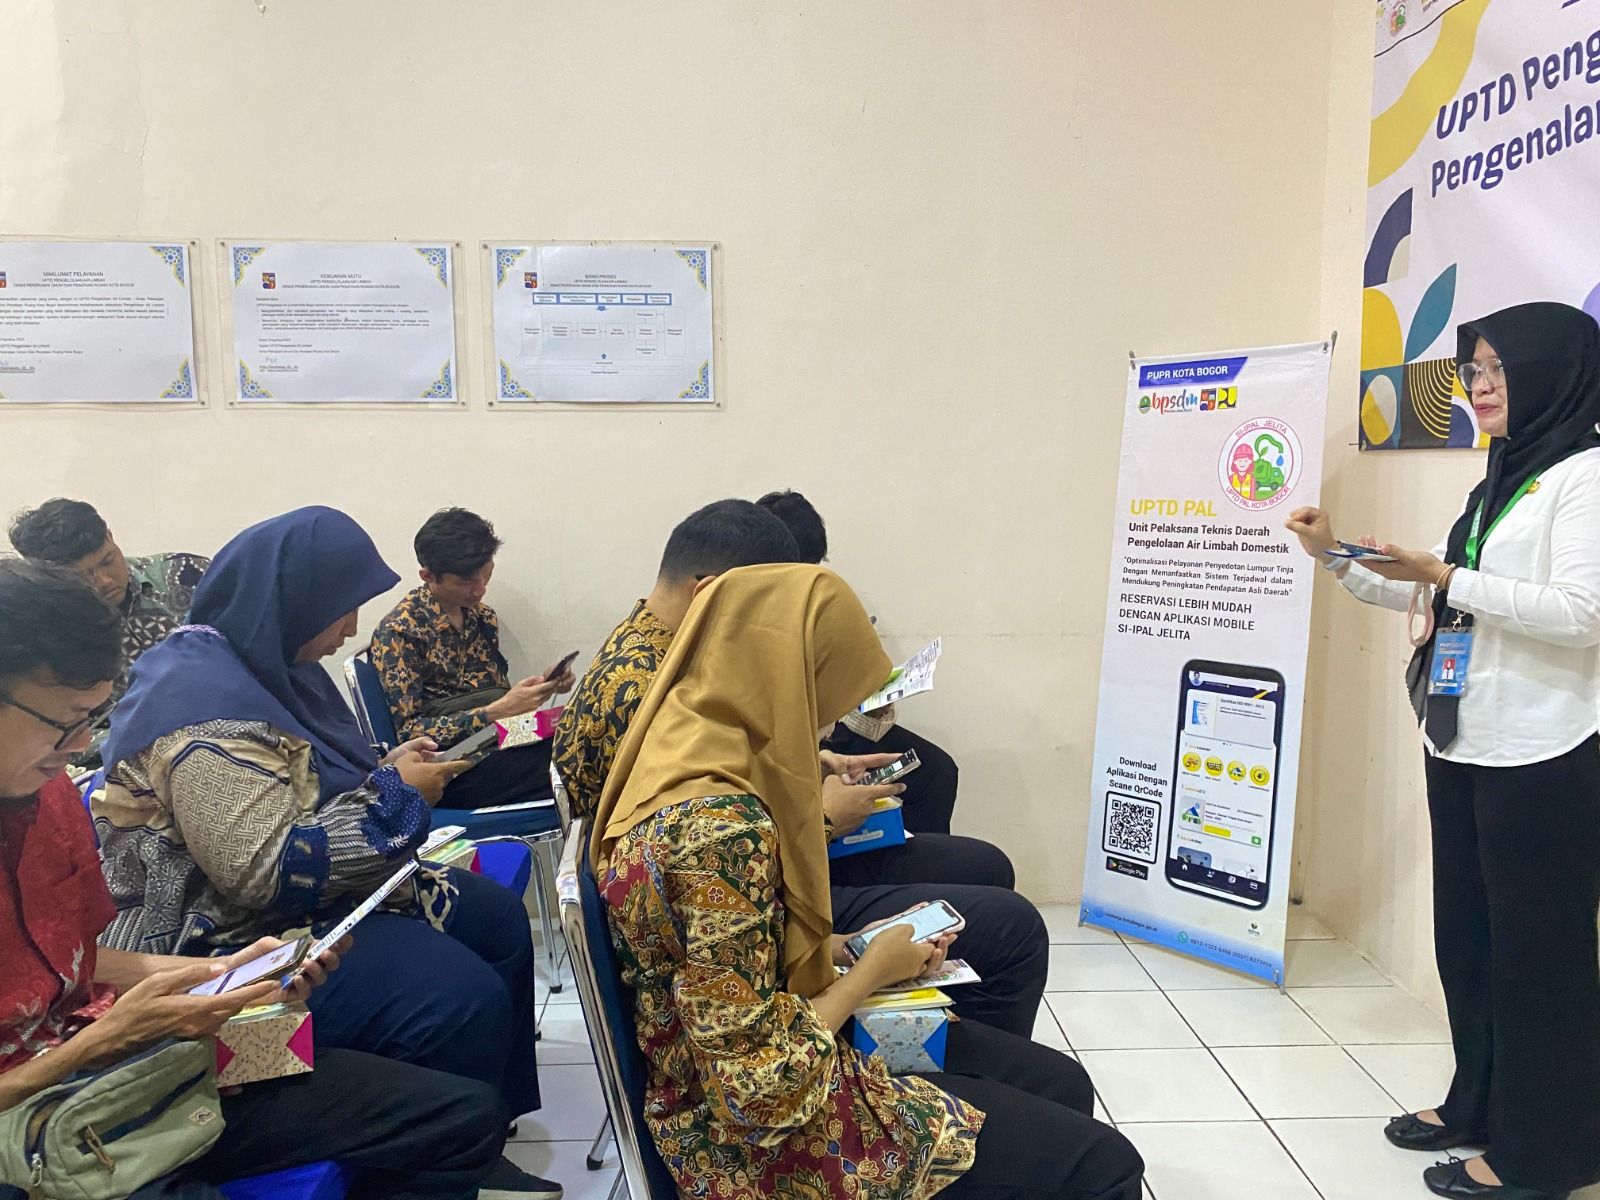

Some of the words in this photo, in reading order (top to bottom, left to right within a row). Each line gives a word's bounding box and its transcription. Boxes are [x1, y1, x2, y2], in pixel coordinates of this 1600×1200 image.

[1436, 73, 1516, 140] UPTD
[1147, 369, 1171, 380] PUPR
[1172, 367, 1195, 378] KOTA
[1196, 365, 1228, 377] BOGOR
[1152, 388, 1198, 415] bpsdm
[1264, 420, 1287, 434] JELITA
[1226, 486, 1240, 502] UPTD
[1239, 499, 1250, 508] PAL
[1251, 500, 1269, 509] KOTA
[1268, 486, 1291, 506] BOGOR
[1130, 499, 1178, 516] UPTD
[1183, 500, 1217, 517] PAL
[1129, 522, 1149, 533] Unit
[1150, 523, 1199, 534] Pelaksana
[1201, 525, 1233, 535] Teknis
[1235, 526, 1270, 537] Daerah
[1127, 537, 1184, 549] Pengelolaan
[1186, 539, 1201, 550] Air
[1203, 540, 1239, 552] Limbah
[1241, 542, 1290, 554] Domestik
[1123, 567, 1148, 577] Dengan
[1151, 569, 1201, 579] Memanfaatkan
[1205, 572, 1229, 581] Sistem
[1233, 574, 1267, 584] Terjadwal
[1270, 576, 1293, 585] dalam
[1168, 559, 1203, 569] Pelayanan
[1205, 561, 1245, 572] Penyedotan
[1247, 563, 1274, 573] Lumpur
[1277, 565, 1294, 575] Tinja
[1122, 577, 1160, 588] Mendukung
[1162, 580, 1204, 590] Peningkatan
[1205, 583, 1246, 594] Pendapatan
[1248, 586, 1262, 595] Asli
[1120, 593, 1176, 607] RESERVASI
[1178, 598, 1209, 610] LEBIH
[1211, 601, 1252, 614] MUDAH
[1119, 608, 1161, 622] DENGAN
[1163, 612, 1211, 626] APLIKASI
[1213, 617, 1255, 631] MOBILE
[1118, 624, 1154, 637] SI-IPAL
[1156, 627, 1191, 641] JELITA
[1119, 756, 1157, 772] Download
[1106, 766, 1137, 780] Aplikasi
[1138, 773, 1168, 787] Dengan
[1109, 779, 1132, 791] Scane
[1134, 785, 1163, 798] QrCode
[1118, 864, 1136, 875] Google
[1135, 869, 1146, 878] Play
